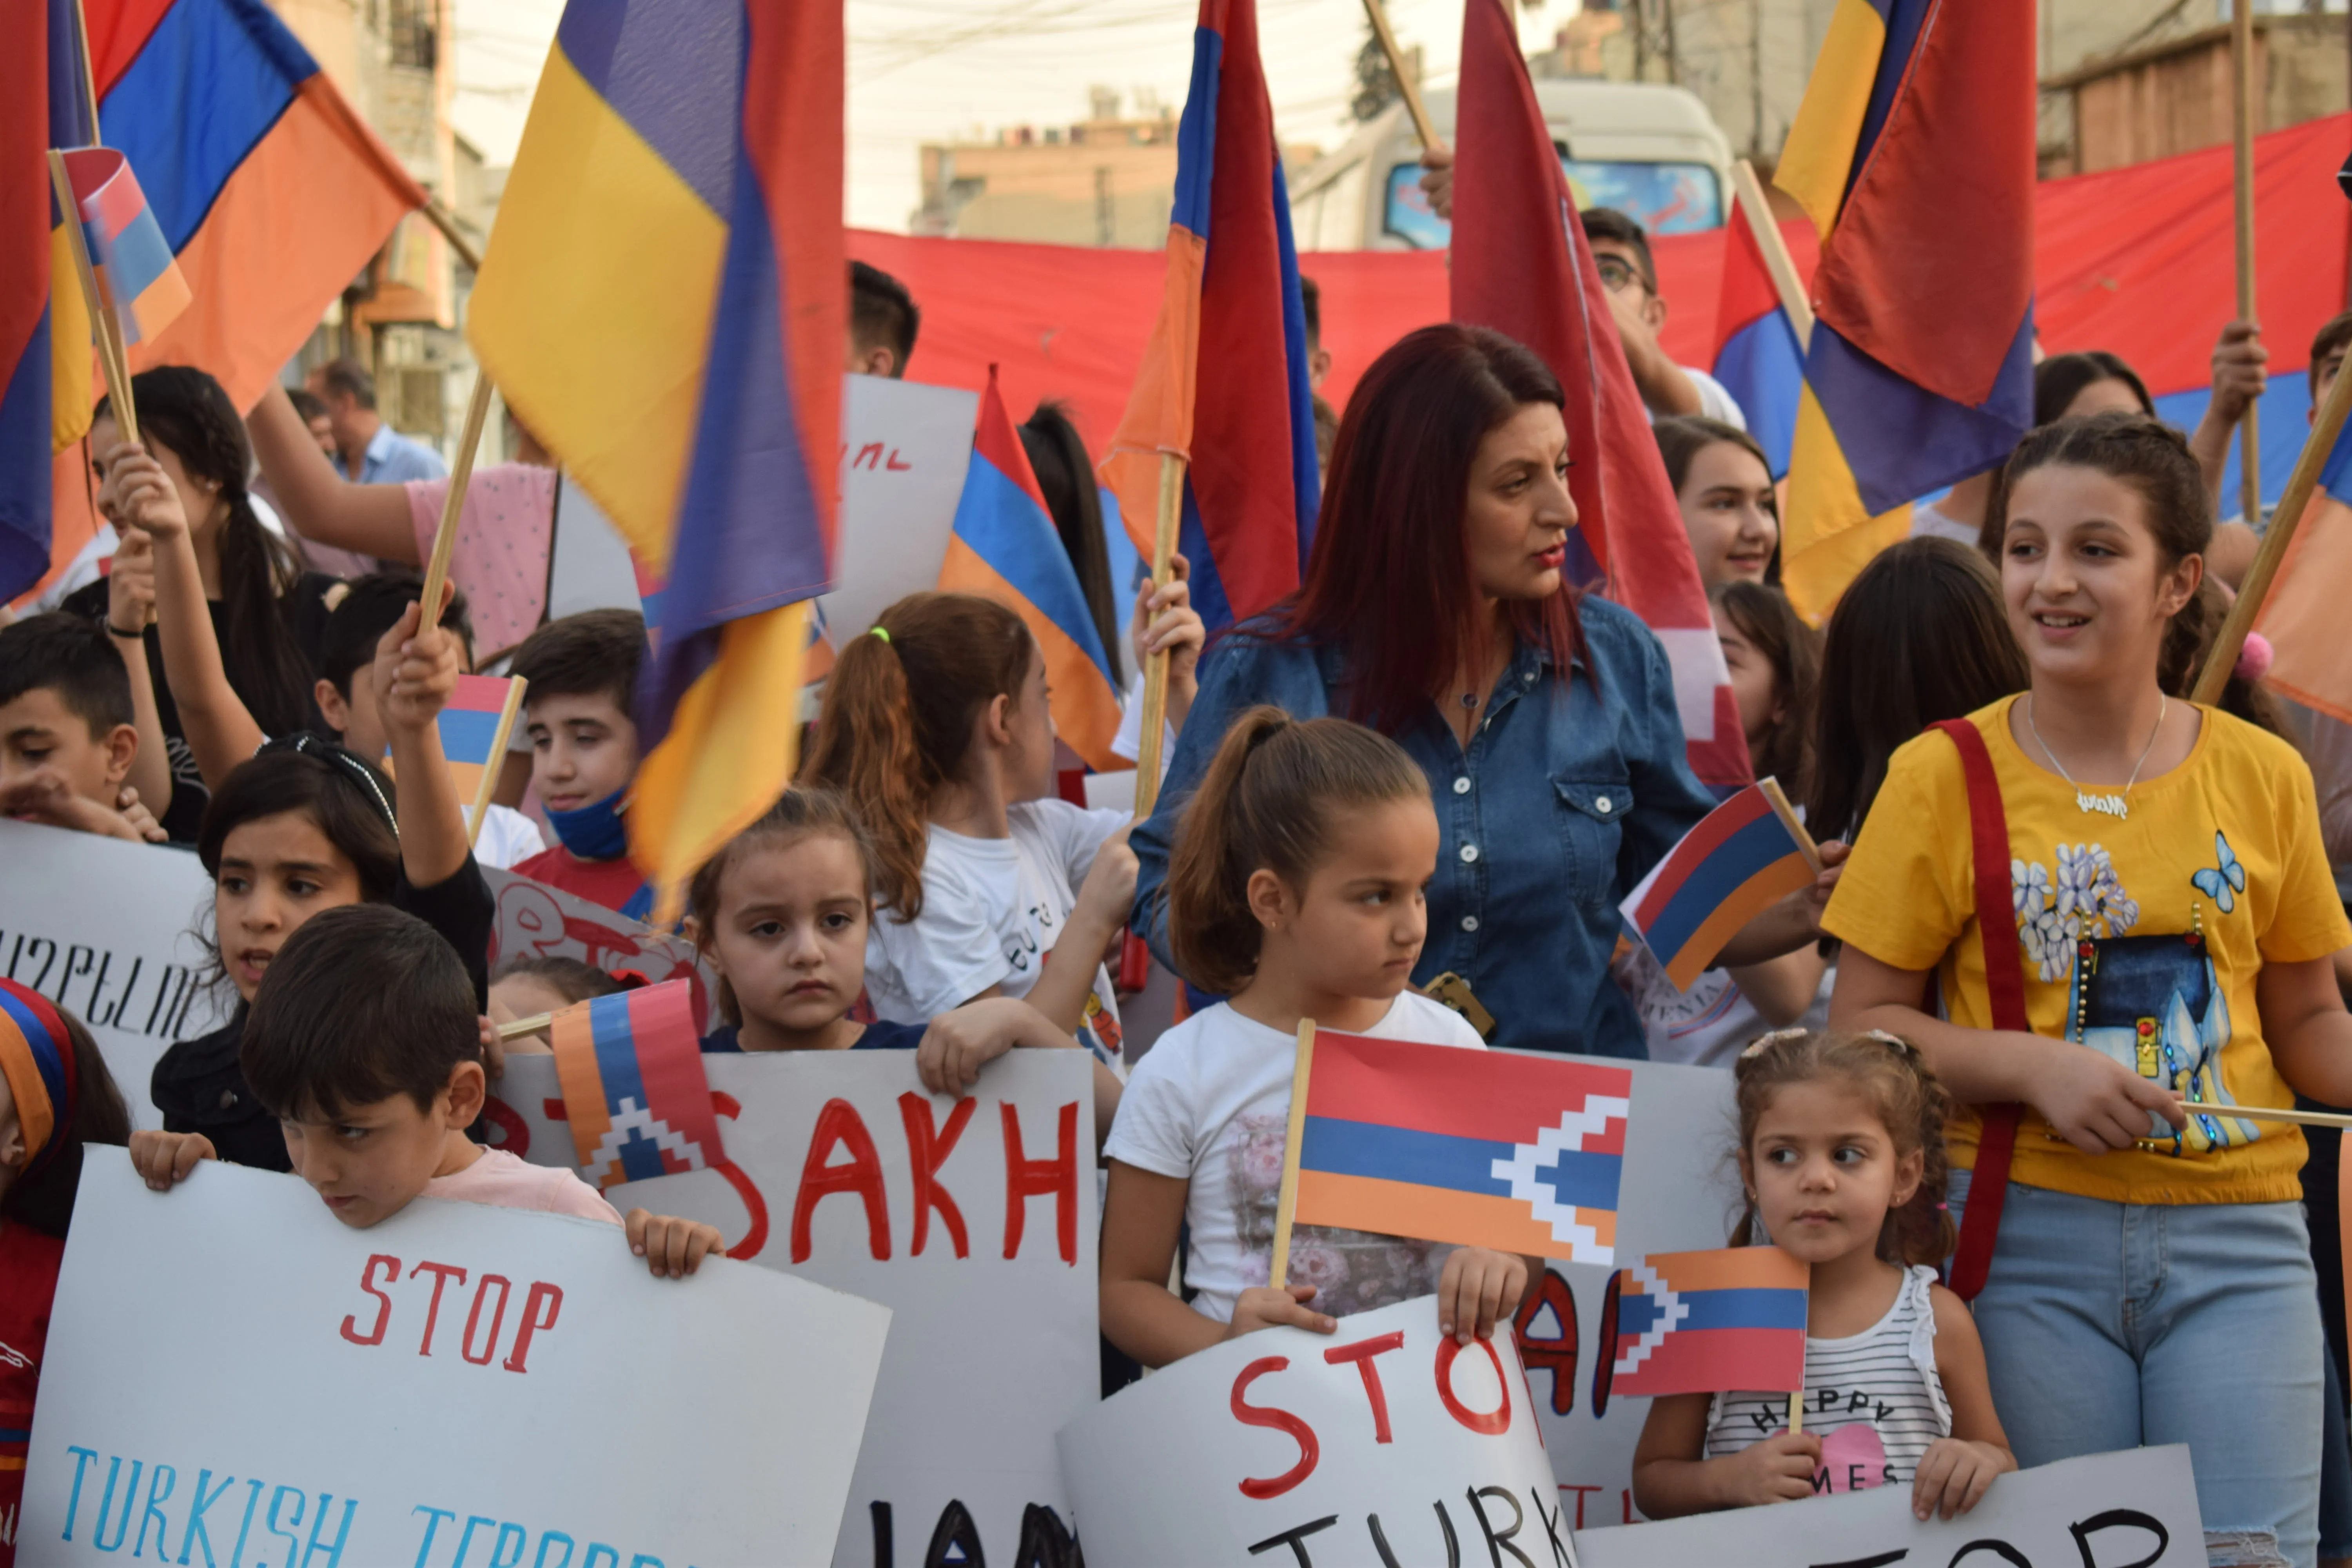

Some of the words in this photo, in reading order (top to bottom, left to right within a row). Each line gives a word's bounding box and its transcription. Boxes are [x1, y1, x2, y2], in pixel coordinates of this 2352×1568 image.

[339, 1253, 564, 1374] STOP
[1231, 1327, 1545, 1501] STO
[62, 1445, 359, 1568] TURKISH
[1809, 1463, 1898, 1494] MES
